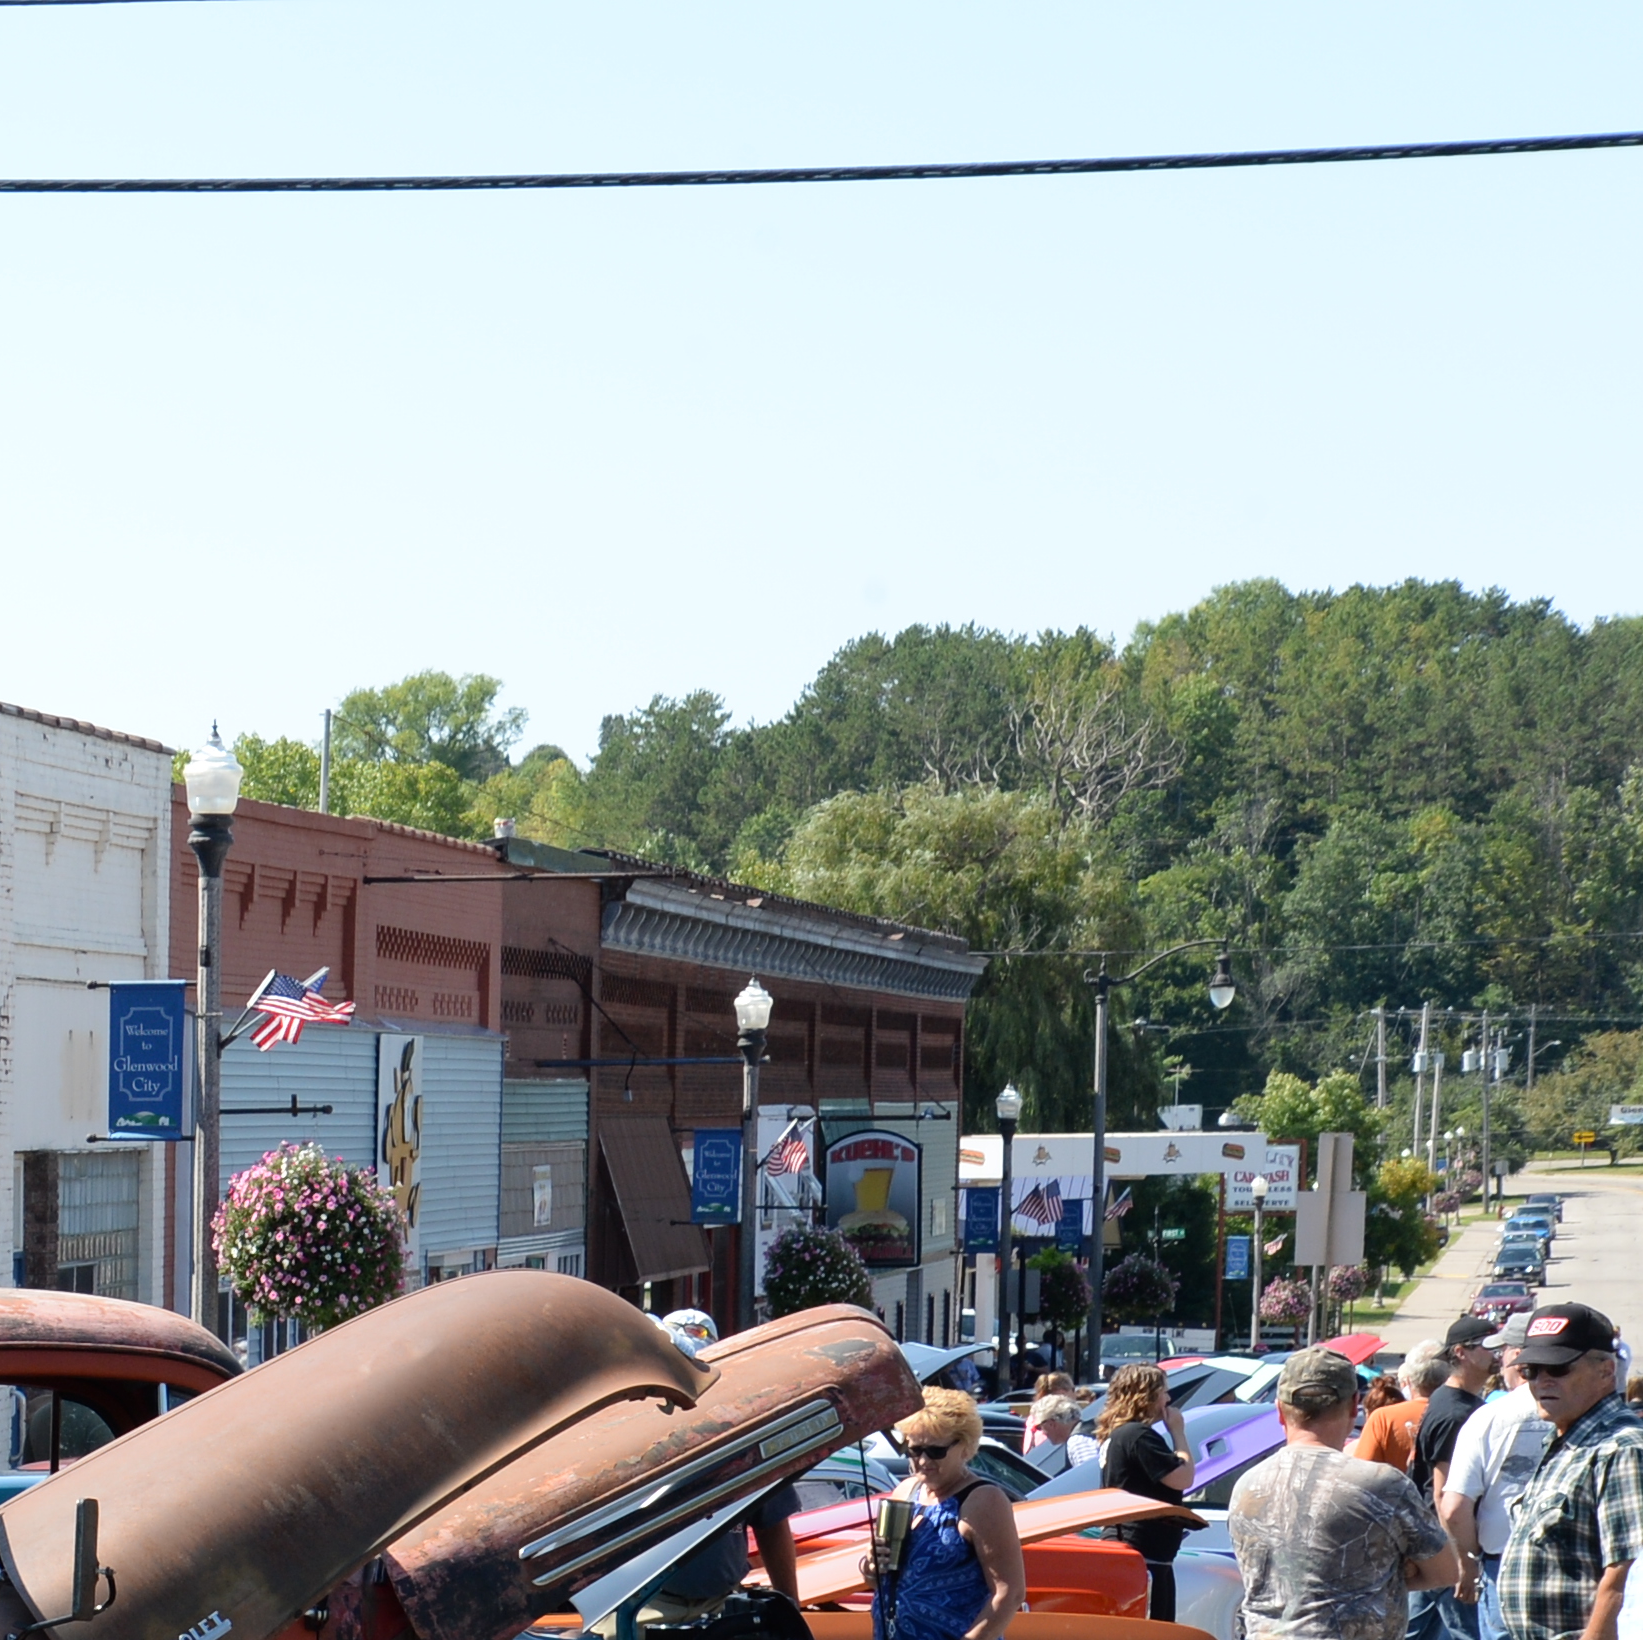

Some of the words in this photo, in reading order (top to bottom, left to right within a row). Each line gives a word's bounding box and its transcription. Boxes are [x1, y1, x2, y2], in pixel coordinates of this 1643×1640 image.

[125, 1023, 169, 1037] Welcome
[141, 1041, 153, 1051] to
[113, 1055, 178, 1073] Glenwood
[131, 1077, 161, 1095] City
